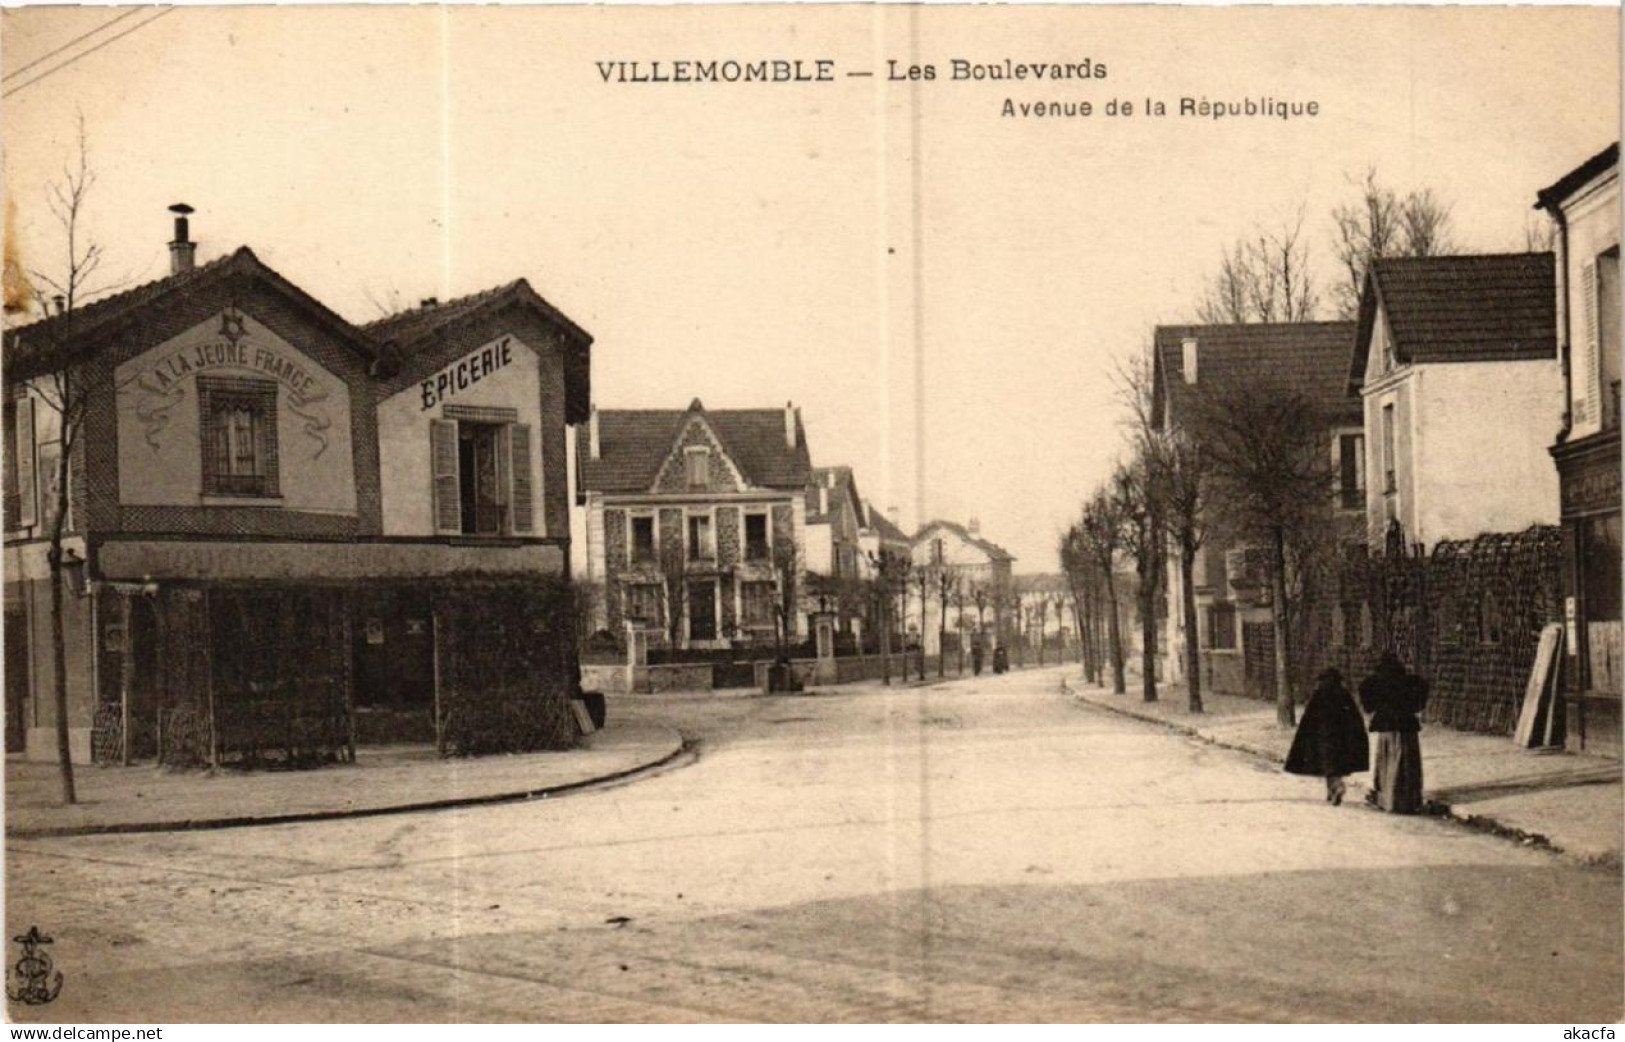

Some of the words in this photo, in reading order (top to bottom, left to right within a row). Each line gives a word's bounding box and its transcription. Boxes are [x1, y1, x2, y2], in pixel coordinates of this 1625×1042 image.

[155, 370, 171, 388] A
[167, 353, 193, 377] LA
[195, 342, 248, 368] JEUNE
[255, 349, 315, 391] FRANCE
[420, 338, 513, 412] EPICERIE
